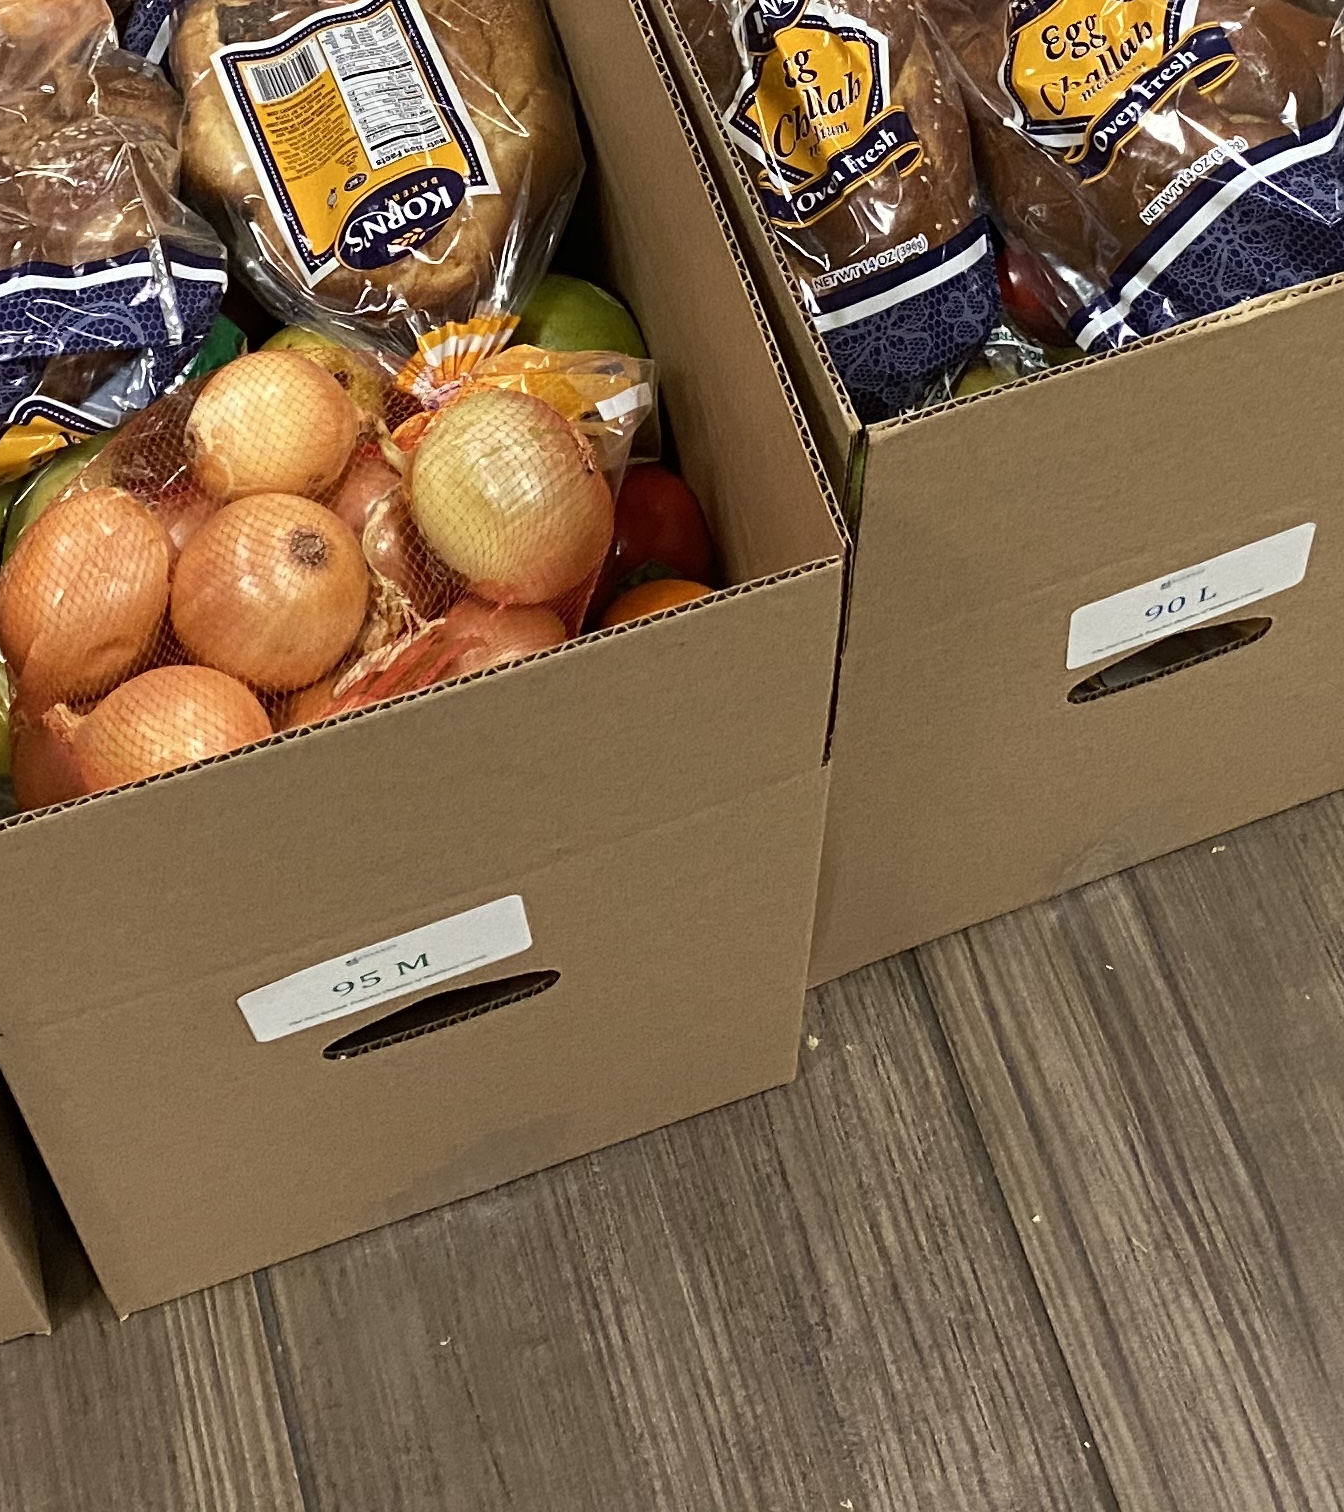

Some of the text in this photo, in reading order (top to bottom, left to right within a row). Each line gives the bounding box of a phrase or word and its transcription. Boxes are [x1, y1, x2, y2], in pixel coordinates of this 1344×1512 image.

[1040, 11, 1108, 62] Egg
[1039, 19, 1154, 117] Challah
[1093, 49, 1199, 153] Oven Fresh
[375, 150, 403, 166] Facts
[840, 129, 899, 174] Fresh
[384, 176, 440, 207] BAKERY
[1142, 199, 1165, 224] NET
[1161, 181, 1181, 203] WT
[1194, 157, 1211, 174] OZ
[345, 185, 454, 253] KORN'S
[814, 273, 837, 289] NET
[837, 265, 859, 282] WT
[862, 258, 877, 273] 14
[877, 251, 896, 266] OZ
[1144, 585, 1217, 623] 90 L
[332, 953, 431, 997] 95 M
